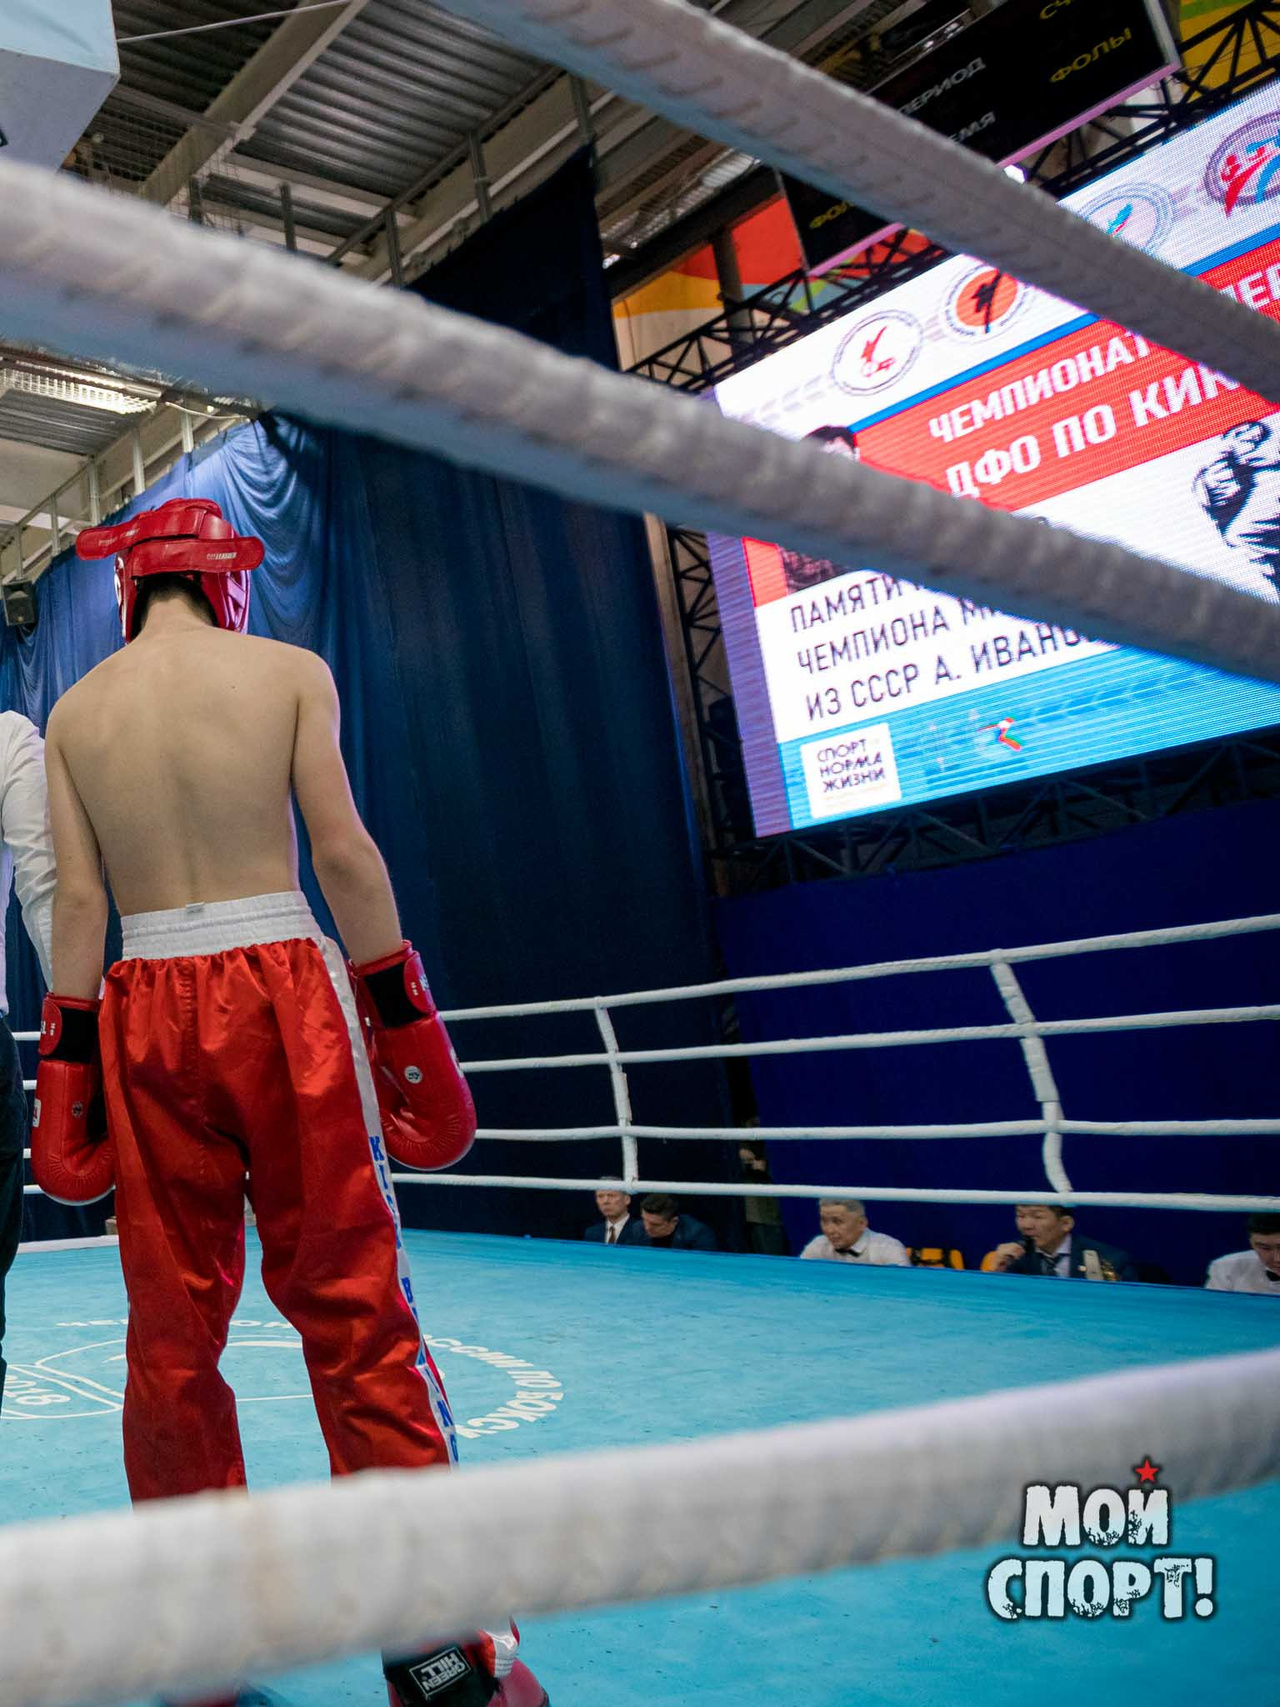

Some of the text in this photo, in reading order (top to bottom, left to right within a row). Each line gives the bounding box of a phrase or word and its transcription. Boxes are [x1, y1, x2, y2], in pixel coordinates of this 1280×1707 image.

[1048, 27, 1132, 83] ФОЛЫ
[946, 434, 1041, 498] ДФО
[1051, 404, 1117, 458] ПО
[791, 574, 902, 633] ПАМЯТИ
[797, 605, 950, 675] ЧЕМПИОНА
[806, 621, 1084, 721] ИЗ СССР А. ИВАНО
[817, 739, 867, 762] СПОРТ
[820, 752, 883, 778] НОРМА
[823, 767, 887, 793] ЖИЗНИ
[422, 1661, 466, 1691] GREEN
